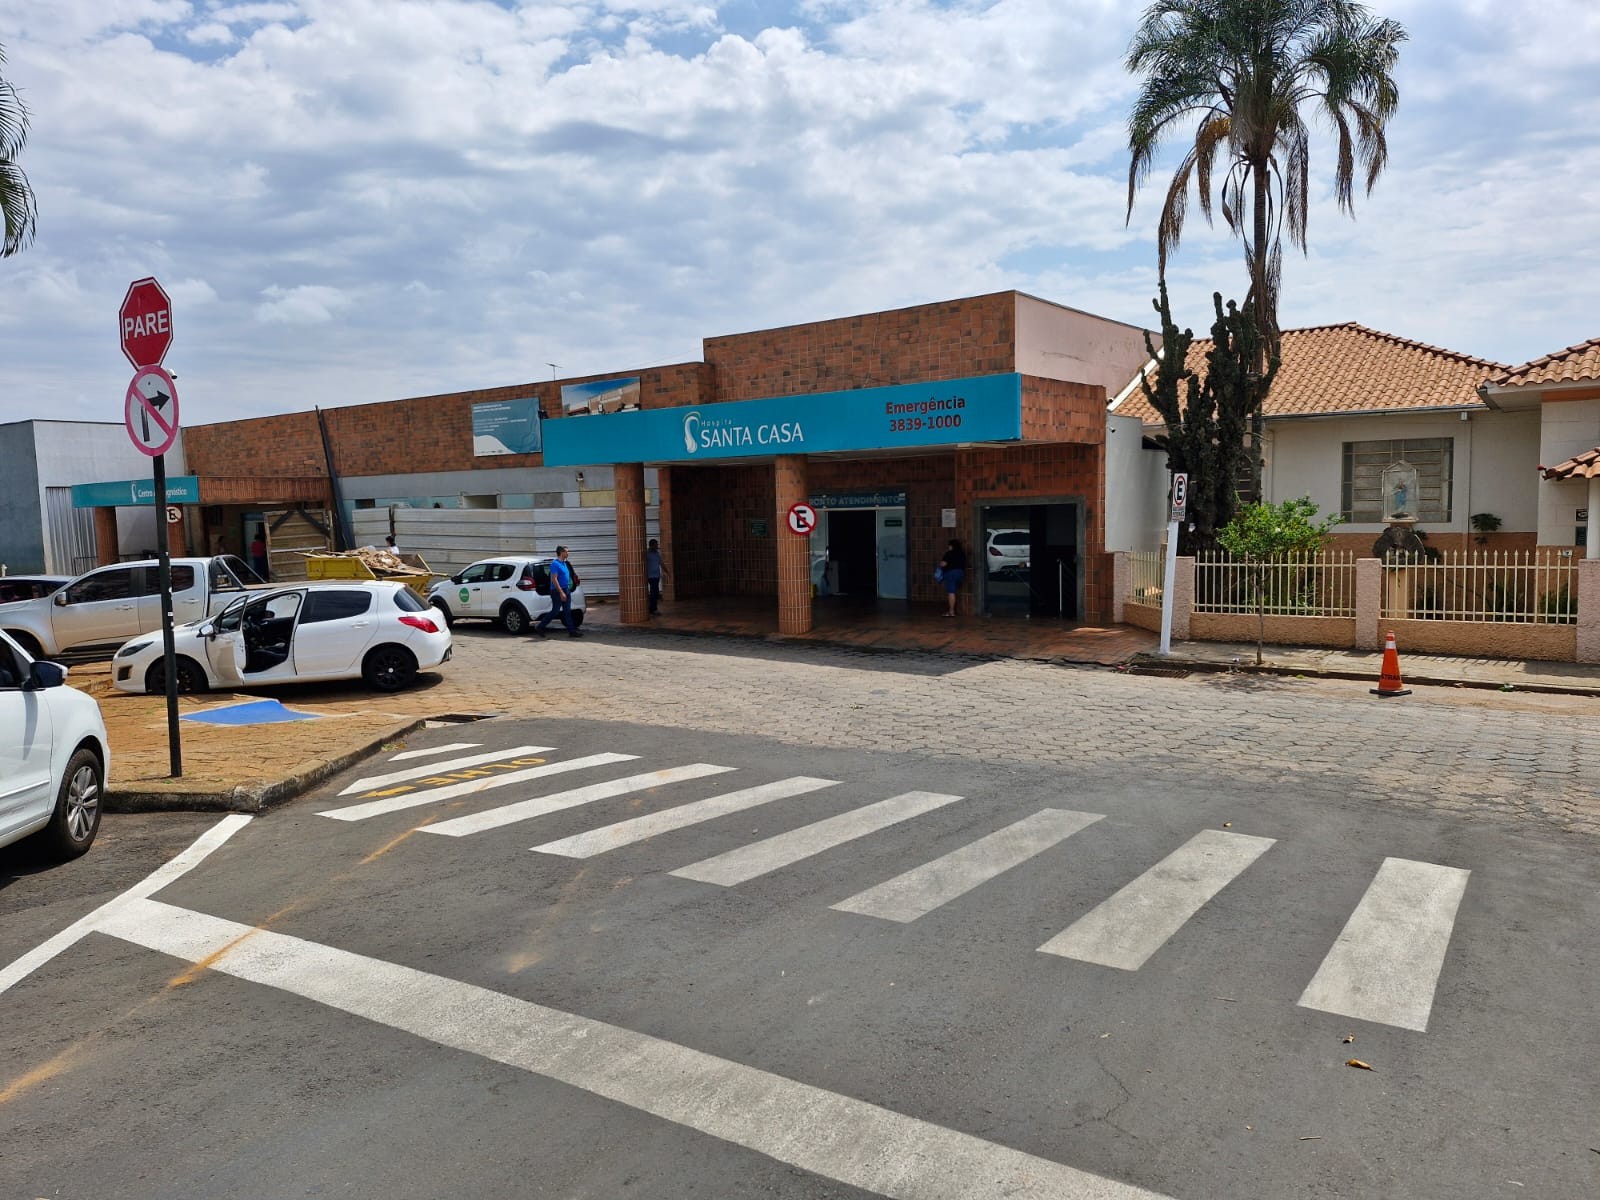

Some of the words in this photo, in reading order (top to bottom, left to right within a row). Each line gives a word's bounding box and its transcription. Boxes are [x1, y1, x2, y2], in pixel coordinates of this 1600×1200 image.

[124, 310, 169, 340] PARE
[885, 396, 966, 415] Emergência
[889, 414, 962, 433] 3839-1000
[701, 426, 753, 448] SANTA
[757, 422, 805, 444] CASA
[137, 489, 153, 498] Centro
[838, 495, 900, 505] ATENDIMENTO
[1176, 480, 1184, 501] E
[796, 509, 807, 529] E
[416, 757, 547, 786] OLHE
